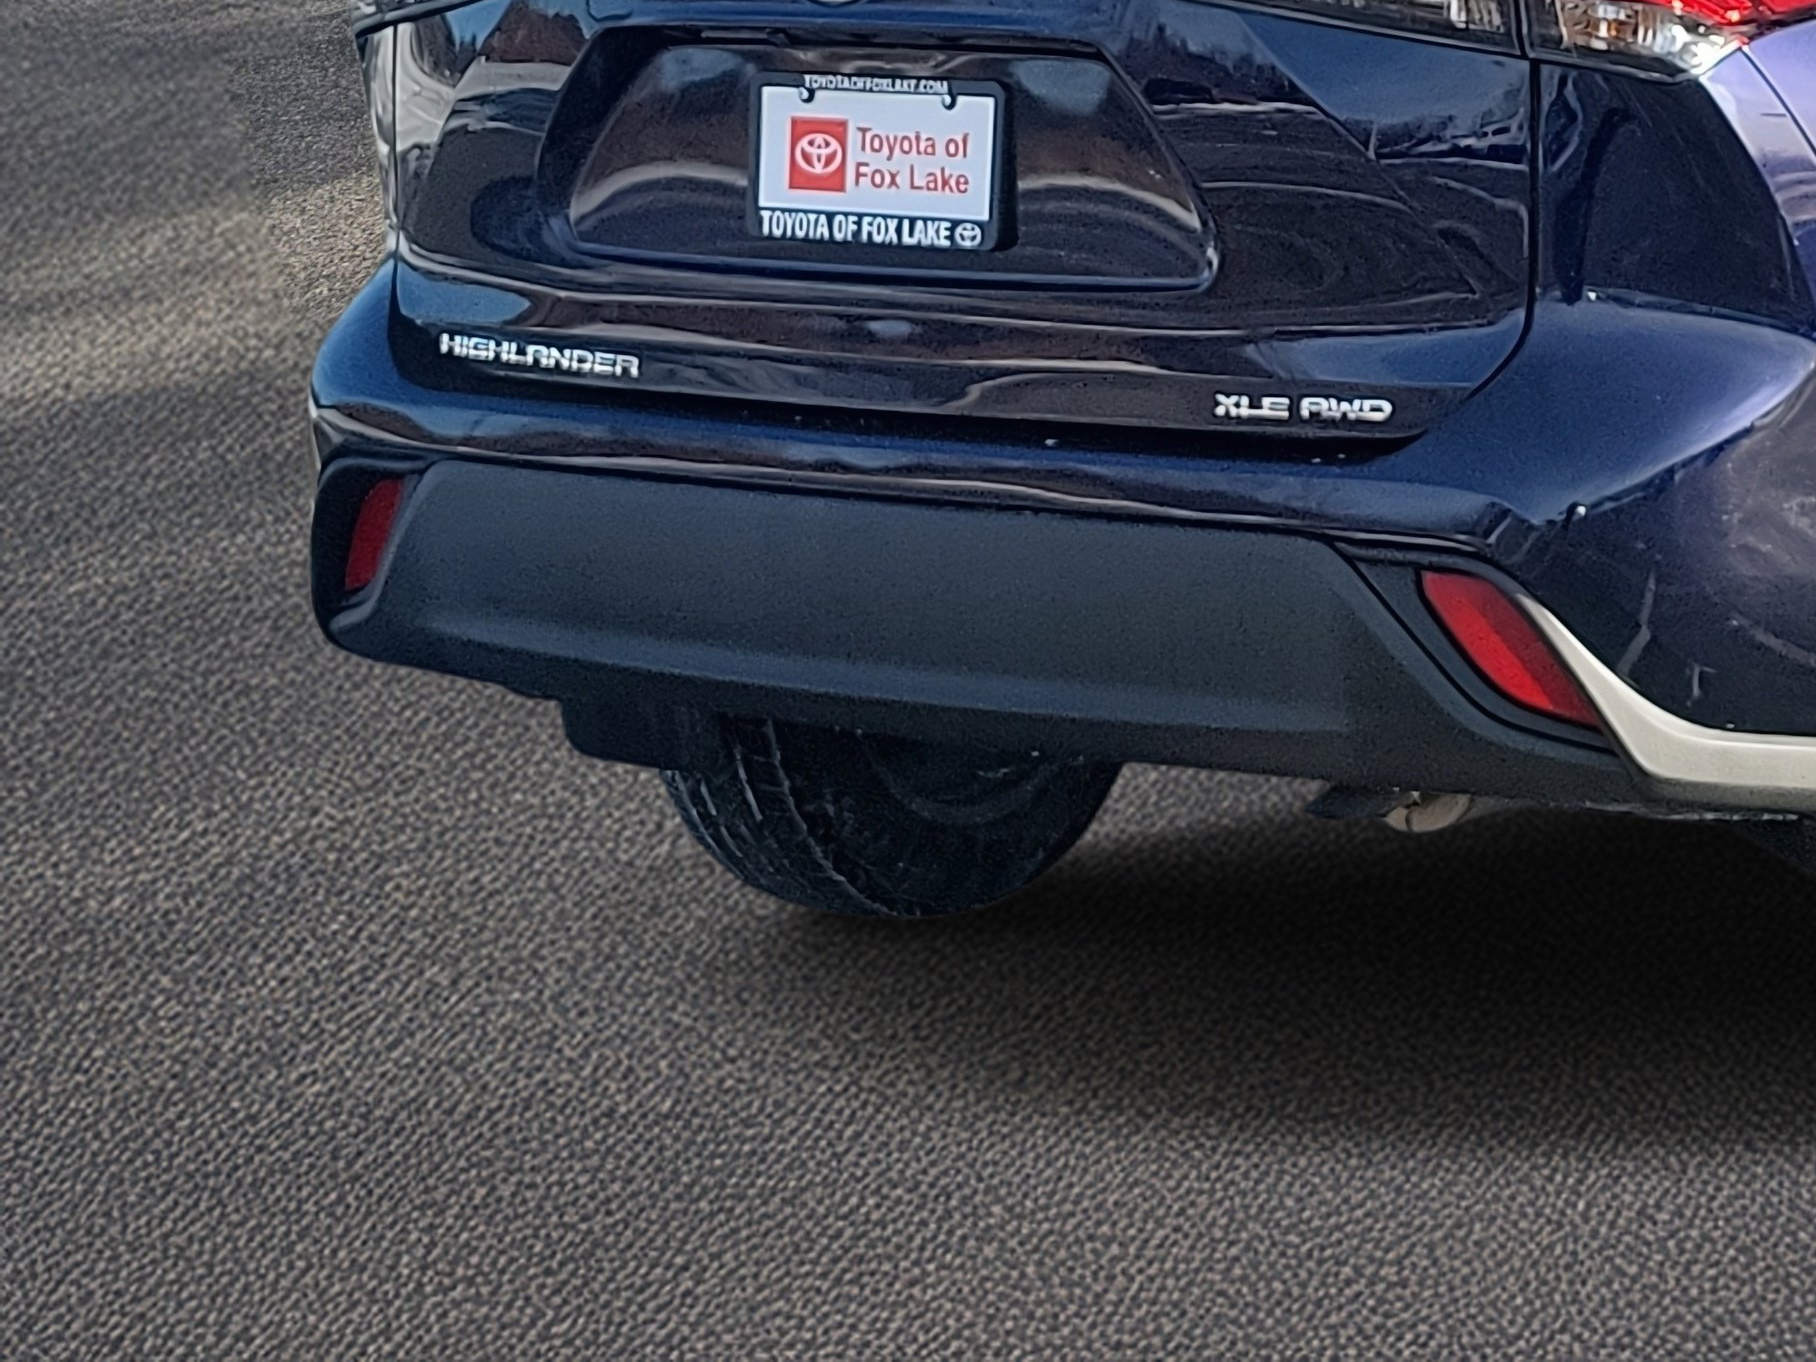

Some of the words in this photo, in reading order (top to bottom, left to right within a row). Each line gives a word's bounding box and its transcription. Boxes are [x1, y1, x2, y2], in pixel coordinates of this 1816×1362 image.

[856, 126, 937, 161] Toyota
[945, 132, 970, 159] of
[855, 162, 900, 190] Fox
[910, 165, 970, 194] Lake
[759, 209, 829, 240] TOYOTA
[832, 213, 858, 242] OF
[861, 216, 899, 245] FOX
[902, 219, 952, 247] LAKE
[439, 333, 640, 378] HIGHLANDER
[1214, 393, 1290, 420] XLE
[1300, 396, 1393, 422] AWD
